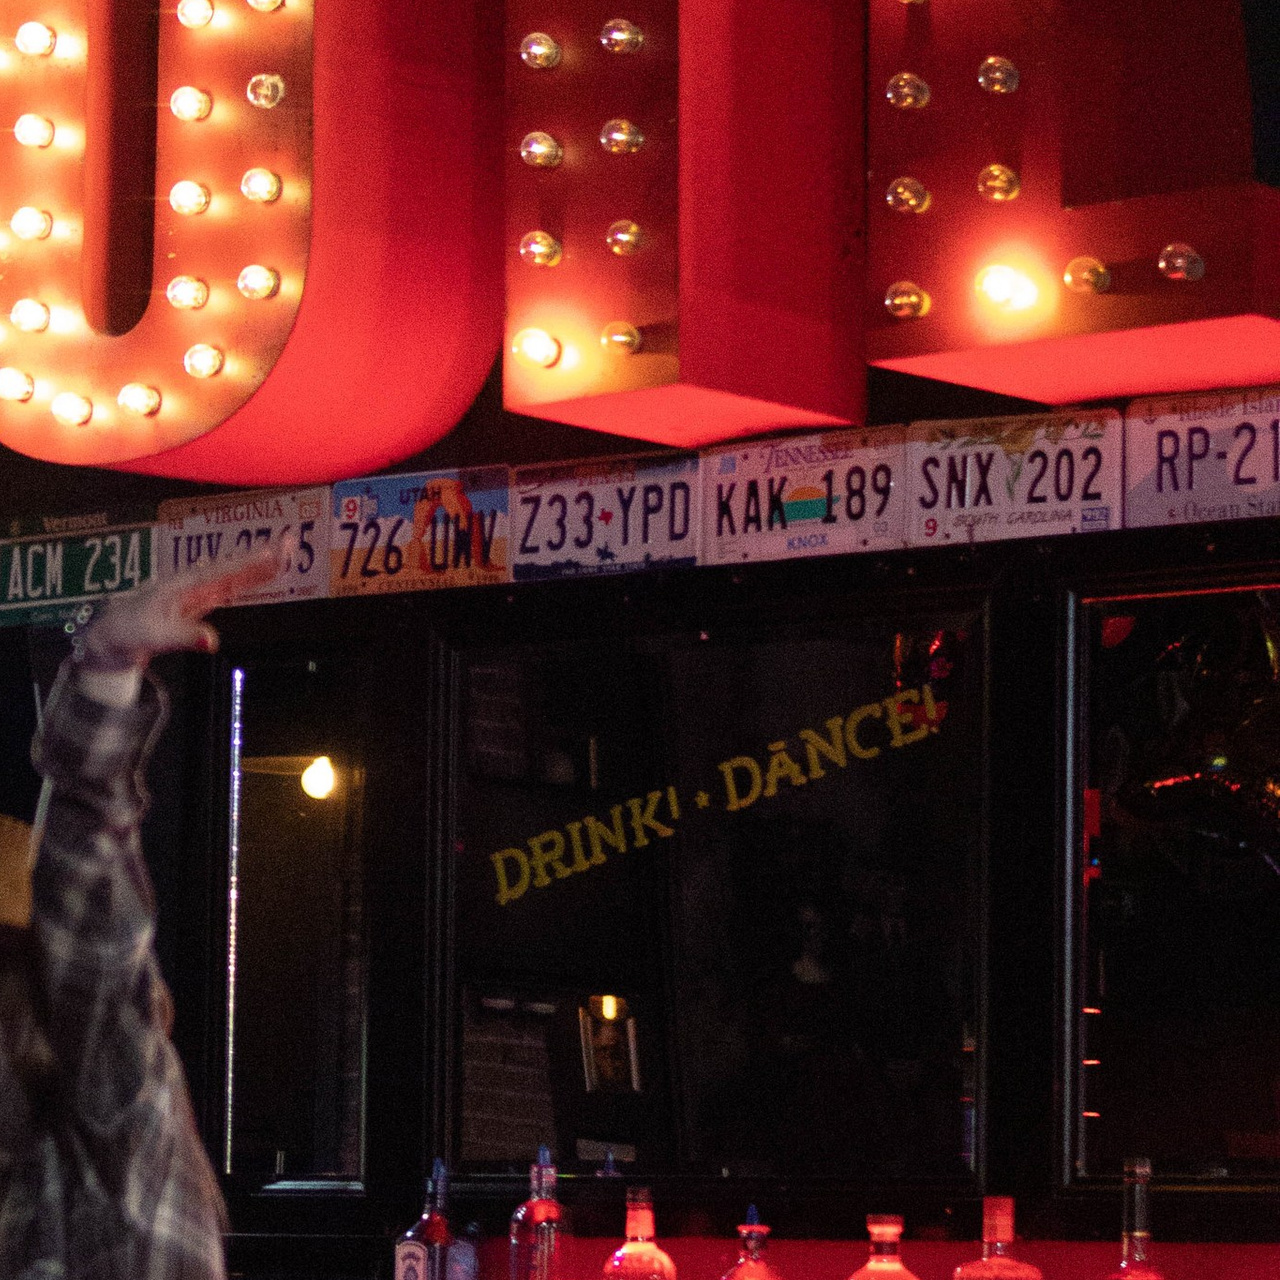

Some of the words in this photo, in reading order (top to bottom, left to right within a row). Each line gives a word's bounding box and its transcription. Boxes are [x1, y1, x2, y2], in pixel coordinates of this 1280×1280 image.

[761, 442, 854, 473] TENNESSEE
[919, 451, 995, 510] SNX
[1027, 446, 1103, 504] 202
[344, 499, 358, 520] 9
[399, 484, 442, 505] UTAH
[716, 476, 789, 537] KAK
[822, 463, 893, 524] 189
[203, 499, 283, 525] VIRGINIA
[519, 491, 595, 554] Z33
[617, 481, 691, 546] YPD
[924, 517, 938, 538] 9
[1006, 508, 1073, 525] CAROLINA
[339, 517, 405, 580] 726
[787, 533, 829, 551] KNOX
[7, 541, 64, 600] ACM
[83, 531, 141, 593] 234
[489, 785, 680, 906] DRINK!
